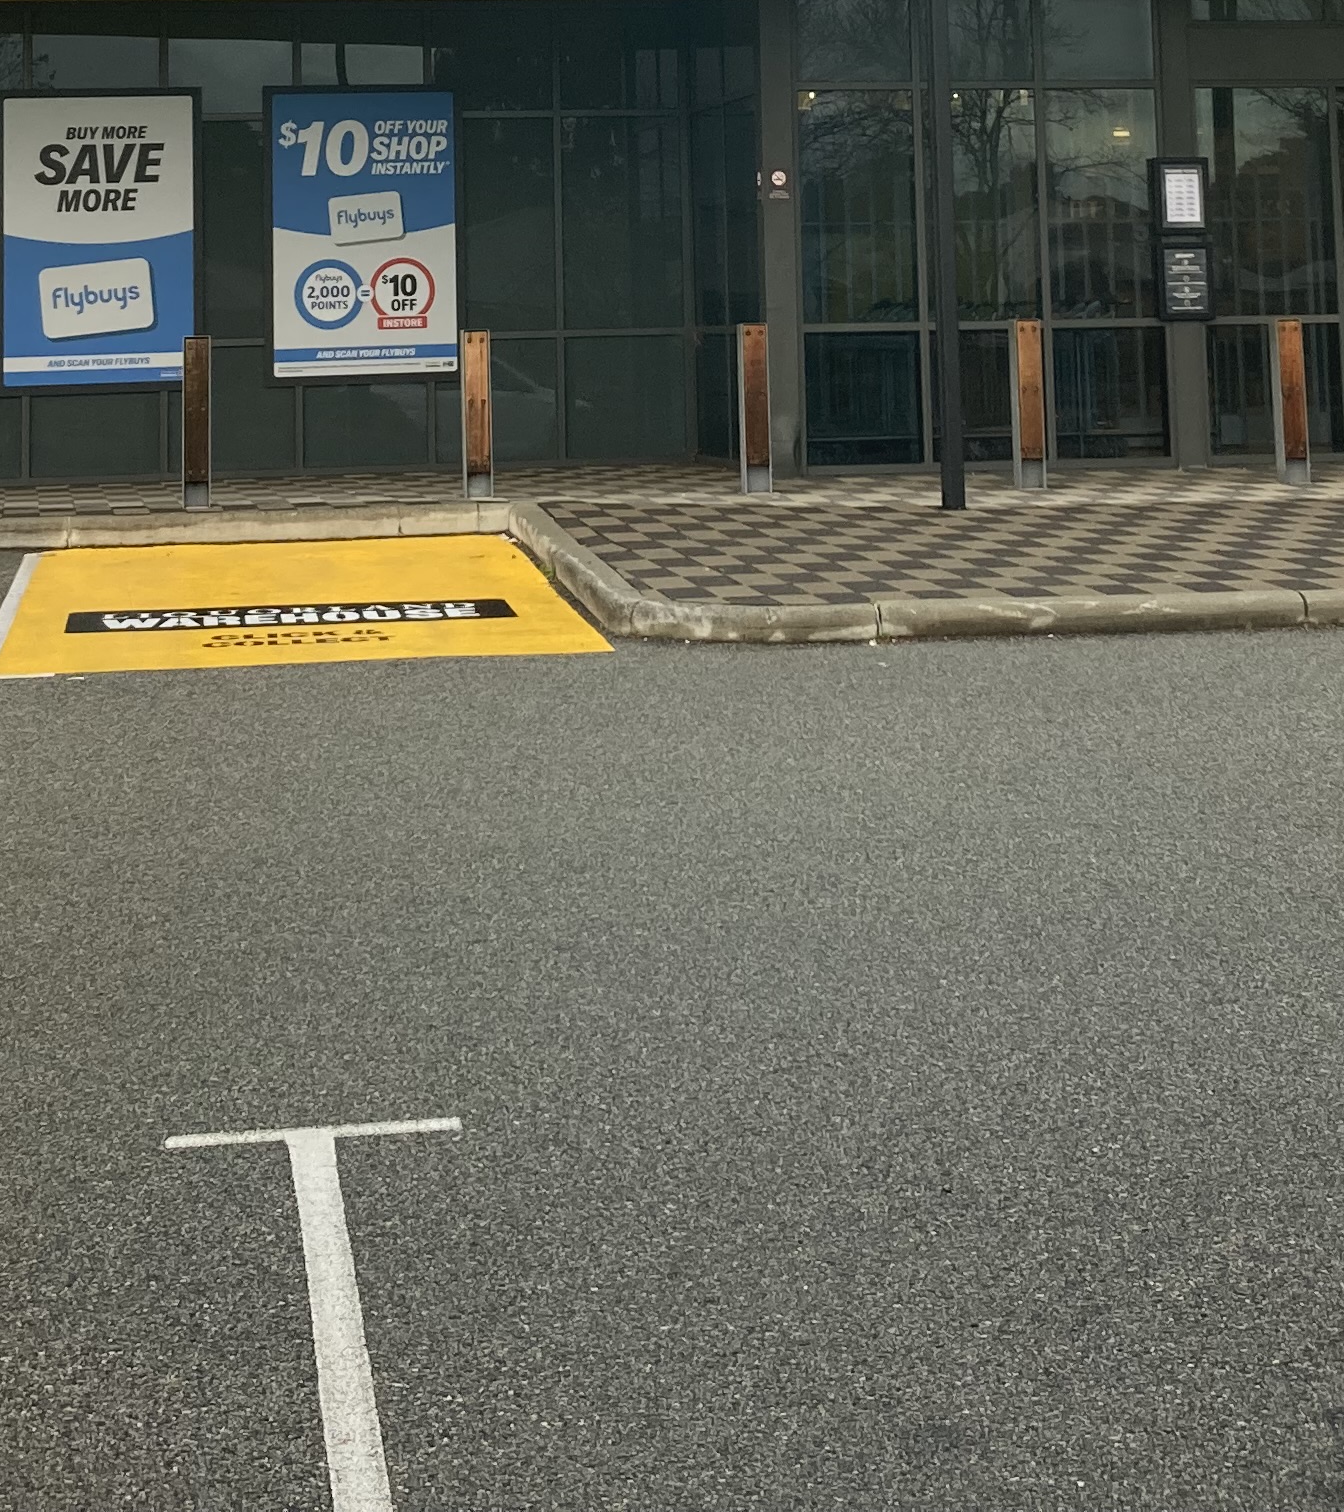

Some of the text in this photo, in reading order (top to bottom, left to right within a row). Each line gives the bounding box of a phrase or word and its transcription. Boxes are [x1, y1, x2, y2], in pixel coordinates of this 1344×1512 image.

[65, 125, 148, 140] BUY MORE
[278, 119, 448, 177] $10 OFF YOUR
[370, 135, 448, 161] SHOP
[34, 143, 165, 186] SAVE
[57, 188, 138, 212] MORE
[307, 285, 350, 300] 2,000
[381, 273, 418, 297] $10
[311, 300, 348, 310] POINTS
[391, 298, 418, 311] OFF
[382, 317, 423, 328] INSTORE
[316, 347, 416, 359] AND SCAN YOUR FLYBUYS
[47, 357, 151, 368] AND SCAN YOUR FLYBUYS
[102, 602, 476, 619] LIQUORLAND
[102, 606, 480, 630] WAREHOUSE
[201, 635, 395, 648] COLLECT
[211, 631, 339, 641] CLICK
